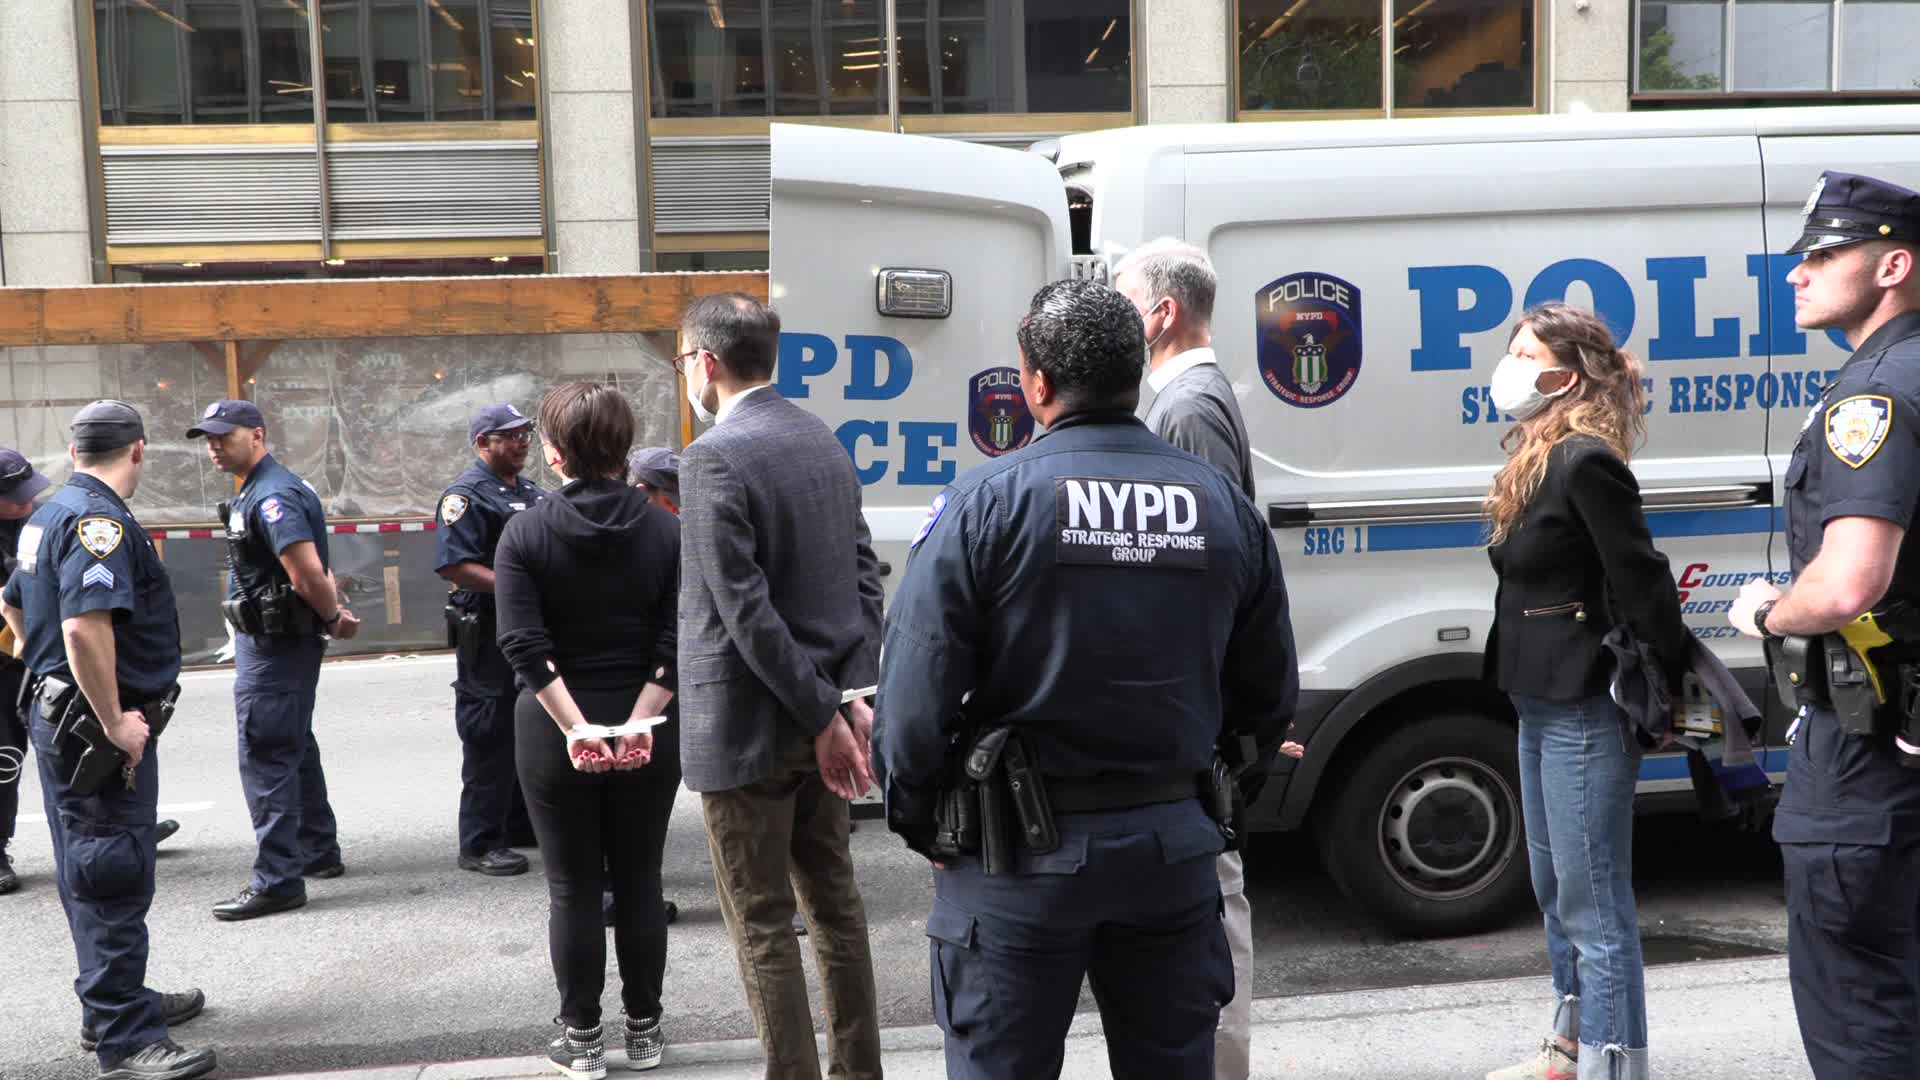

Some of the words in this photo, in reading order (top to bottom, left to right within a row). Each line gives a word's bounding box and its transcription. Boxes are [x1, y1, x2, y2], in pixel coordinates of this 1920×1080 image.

[1268, 278, 1350, 312] POLICE
[1295, 311, 1324, 321] NYPD
[1408, 254, 1855, 372] POLI
[1065, 479, 1198, 533] NYPD
[1061, 528, 1134, 548] STRATEGIC
[1137, 532, 1206, 551] RESPONSE
[1111, 546, 1157, 563] GROUP
[1303, 526, 1345, 556] SRG
